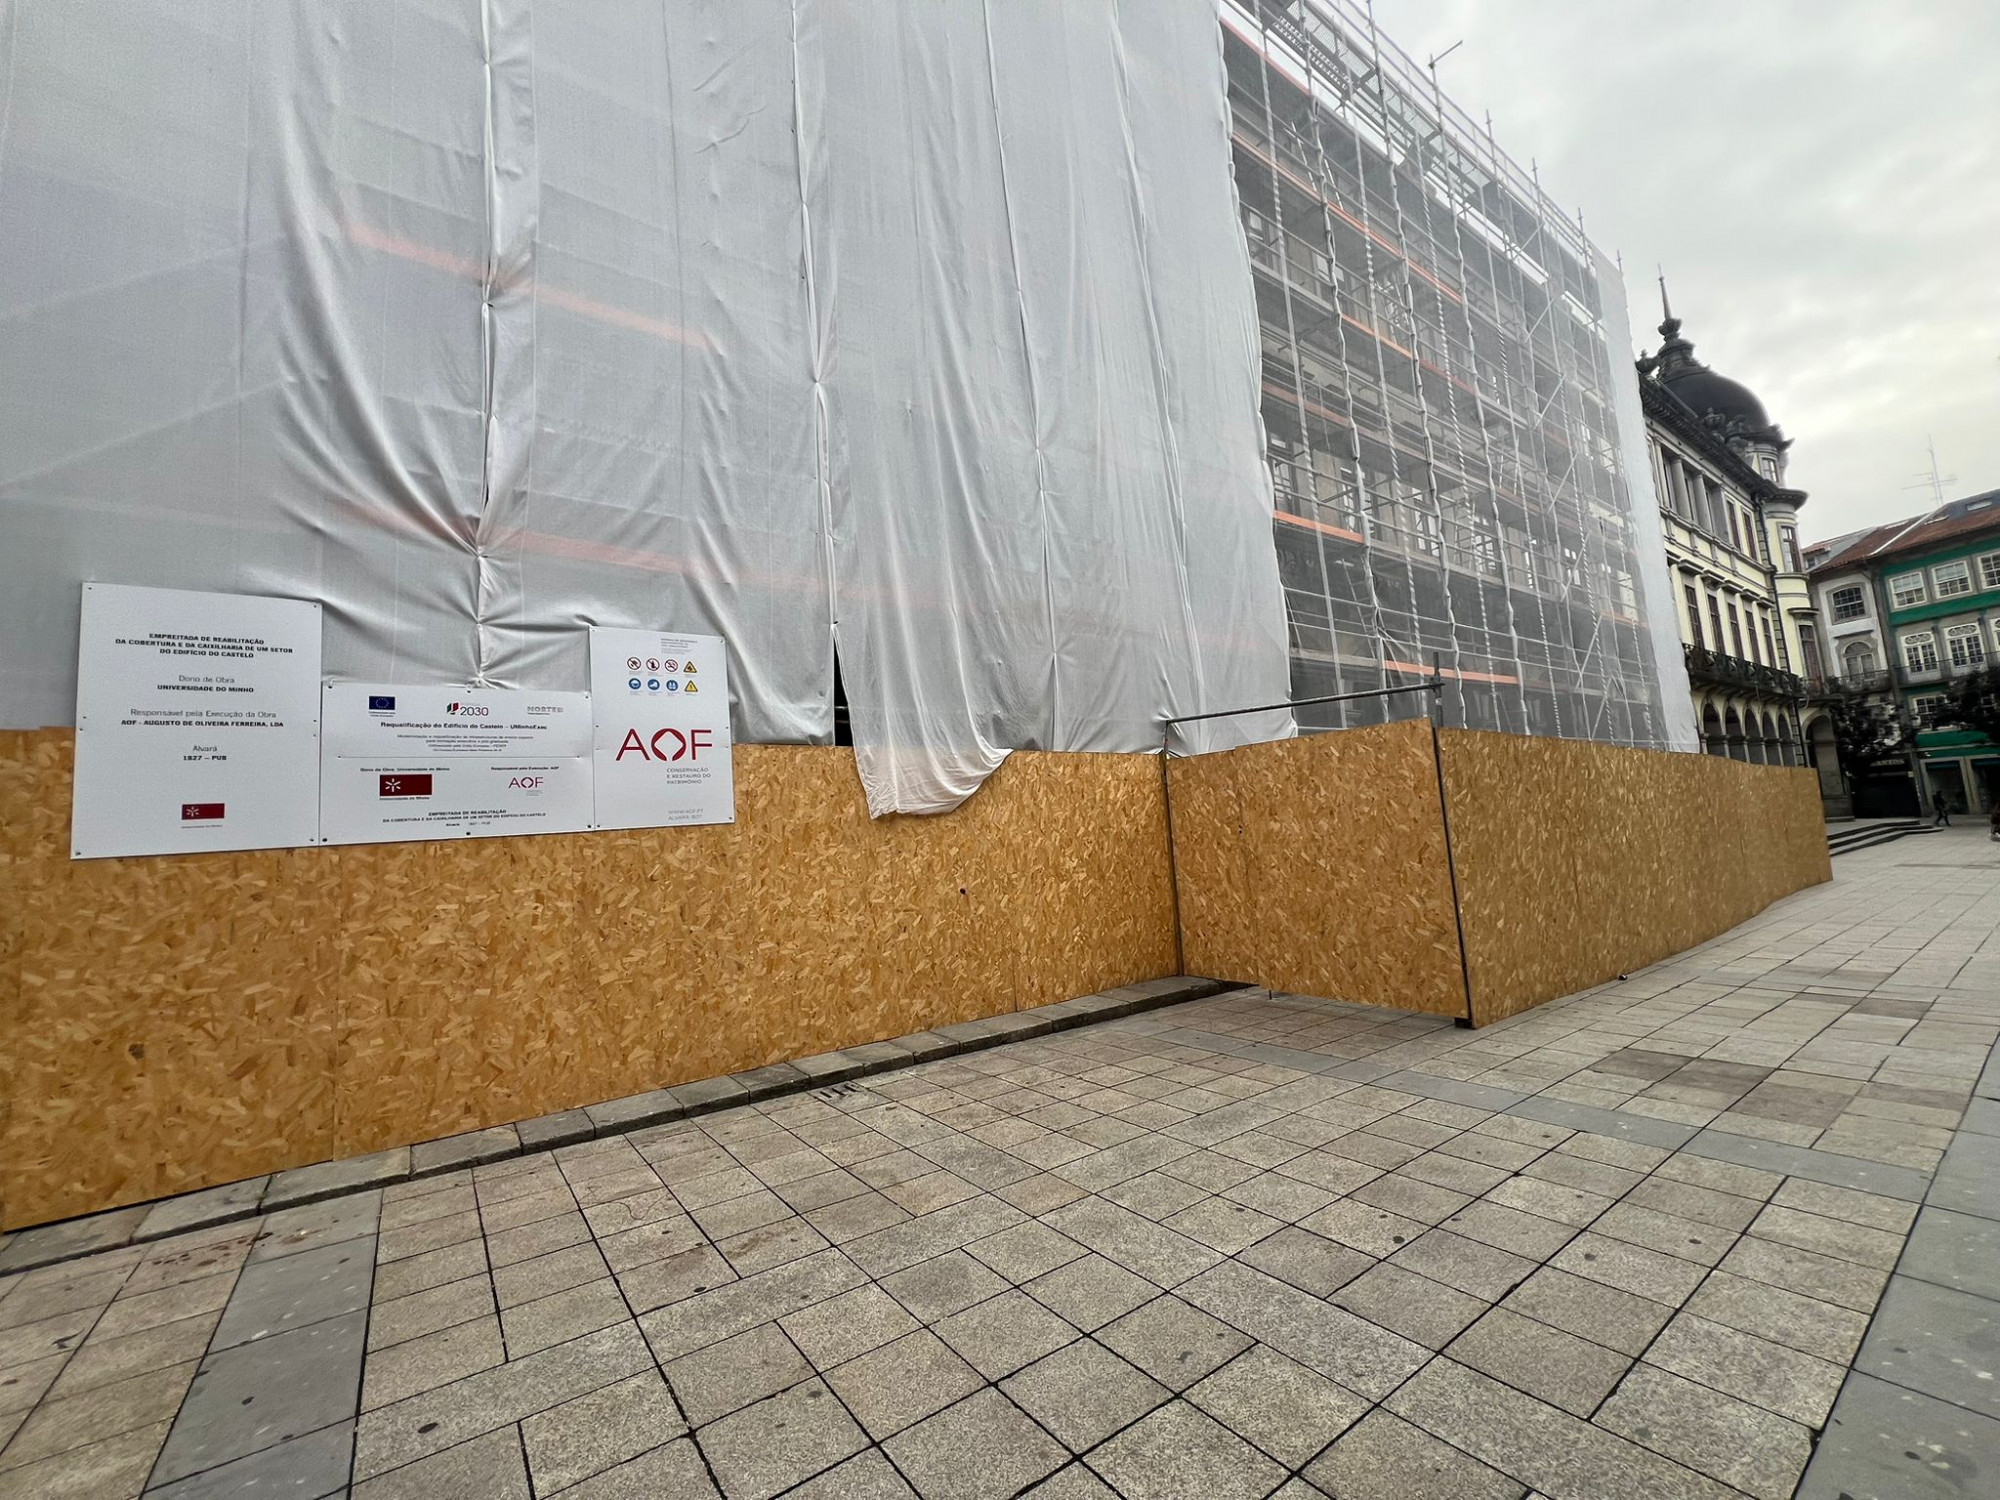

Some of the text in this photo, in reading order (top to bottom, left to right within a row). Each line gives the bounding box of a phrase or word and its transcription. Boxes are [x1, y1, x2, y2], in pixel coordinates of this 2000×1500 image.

[128, 639, 176, 647] COBERTURA
[149, 633, 198, 641] EMPREITADA
[212, 636, 265, 645] REABILITAÇÃO
[178, 674, 201, 682] Dono
[215, 676, 235, 684] Obra
[157, 684, 214, 692] UNIVERSIDADE
[205, 710, 243, 718] Execução
[460, 707, 489, 717] 2030
[380, 721, 431, 729] Requalificação
[615, 728, 713, 762] AOF
[508, 776, 544, 789] AOF
